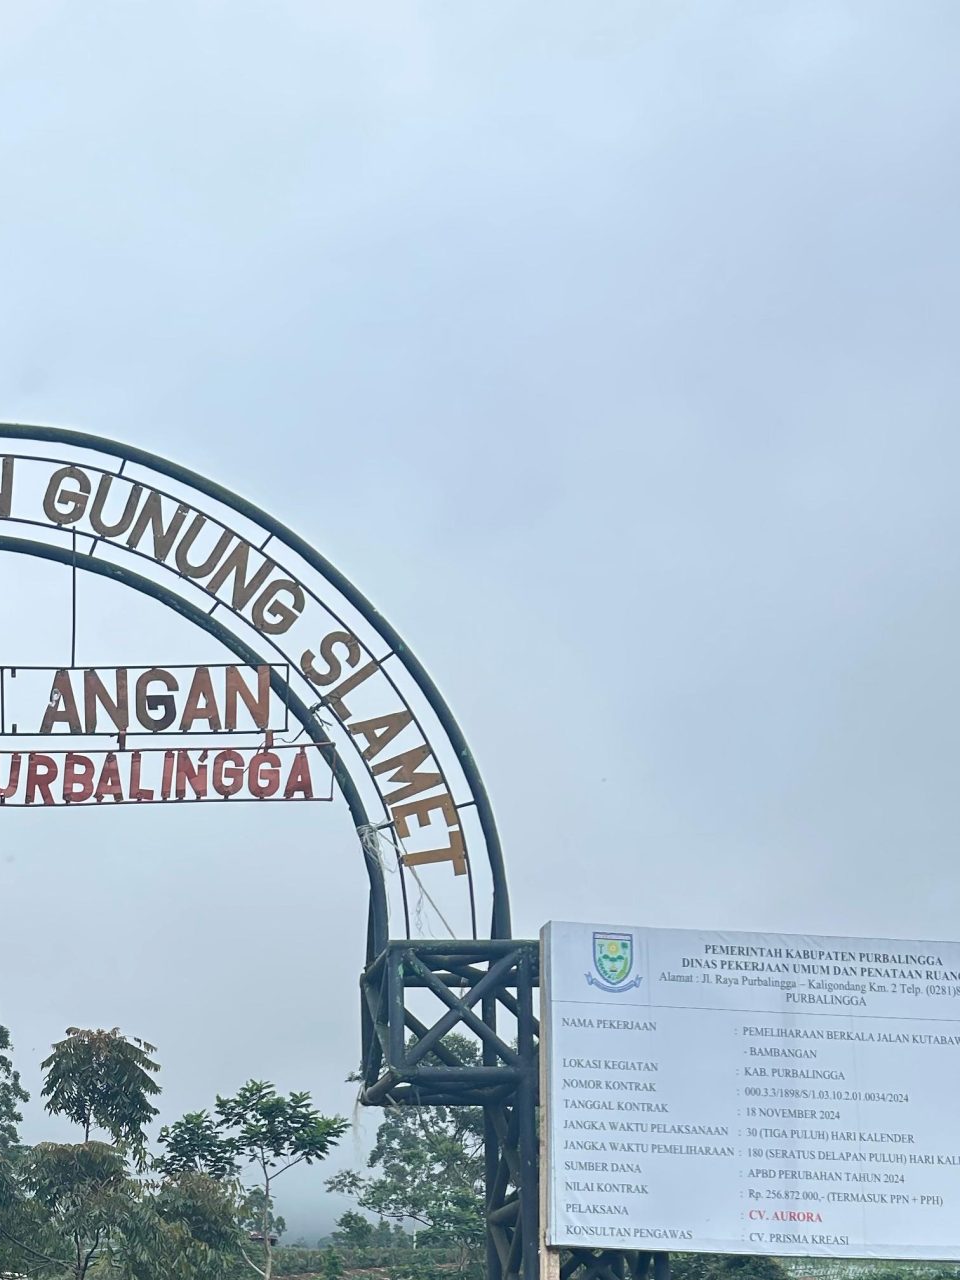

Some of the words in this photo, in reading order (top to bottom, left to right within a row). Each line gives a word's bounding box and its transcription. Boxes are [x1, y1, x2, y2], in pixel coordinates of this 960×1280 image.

[43, 465, 305, 636] GUNUNG
[300, 630, 468, 876] SLAMET
[704, 944, 782, 958] PEMERINTAH
[786, 948, 856, 962] KABUPATEN
[859, 952, 943, 966] PURBALINGGA
[681, 957, 717, 969] DINAS
[720, 959, 789, 973] PEKERJAAN
[793, 963, 830, 976] UMUM
[833, 965, 857, 977] DAN
[860, 967, 922, 979] PENATAAN
[659, 971, 693, 983] Alamat
[715, 974, 739, 987] Raya
[741, 975, 796, 990] Purbalingga
[808, 979, 866, 993] Kaligondang
[869, 982, 889, 993] Km.
[891, 983, 897, 993] 2
[900, 984, 923, 997] Telp.
[786, 993, 867, 1006] PURBALINGGA
[561, 1017, 594, 1028] NAMA
[597, 1019, 657, 1031] PEKERJAAN
[743, 1027, 823, 1039] PEMELIHARAAN
[826, 1030, 874, 1042] BERKALA
[877, 1032, 909, 1043] JALAN
[749, 1047, 817, 1058] BAMBANGAN
[563, 1058, 601, 1069] LOKASI
[604, 1060, 658, 1071] KEGIATAN
[744, 1067, 768, 1077] KAB.
[771, 1068, 845, 1080] PURBALINGGA
[563, 1078, 602, 1089] NOMOR
[605, 1080, 656, 1092] KONTRAK
[563, 1099, 614, 1110] TANGGAL
[617, 1101, 669, 1113] KONTRAK
[746, 1107, 756, 1117] 18
[759, 1107, 817, 1119] NOVEMBER
[820, 1110, 840, 1120] 2024
[563, 1119, 606, 1131] JANGKA
[608, 1121, 648, 1133] WAKTU
[650, 1123, 728, 1136] PELAKSANAAN
[746, 1127, 757, 1137] 30
[759, 1128, 787, 1139] (TIGA
[790, 1129, 829, 1142] PULUH)
[831, 1131, 856, 1141] HARI
[859, 1132, 915, 1144] KALENDER
[563, 1140, 607, 1151] JANGKA
[609, 1141, 648, 1153] WAKTU
[651, 1143, 734, 1156] PEMELIHARAAN
[747, 1148, 763, 1158] 180
[765, 1149, 816, 1161] (SERATUS
[818, 1151, 867, 1162] DELAPAN
[869, 1153, 907, 1165] PULUH)
[909, 1154, 935, 1165] HARI
[564, 1161, 609, 1172] SUMBER
[611, 1162, 641, 1173] DANA
[747, 1169, 776, 1179] APBD
[778, 1170, 842, 1181] PERUBAHAN
[844, 1172, 881, 1183] TAHUN
[883, 1174, 905, 1184] 2024
[565, 1181, 594, 1192] NILAI
[597, 1183, 648, 1194] KONTRAK
[748, 1189, 763, 1201] Rp.
[827, 1191, 888, 1204] (TERMASUK
[890, 1194, 909, 1204] PPN
[920, 1195, 944, 1207] PPH)
[565, 1203, 629, 1216] PELAKSANA
[749, 1210, 769, 1221] CV.
[772, 1211, 822, 1223] AURORA
[565, 1225, 631, 1237] KONSULTAN
[633, 1228, 693, 1240] PENGAWAS
[749, 1232, 768, 1243] CV.
[769, 1233, 809, 1244] PRISMA
[811, 1234, 849, 1246] KREASI
